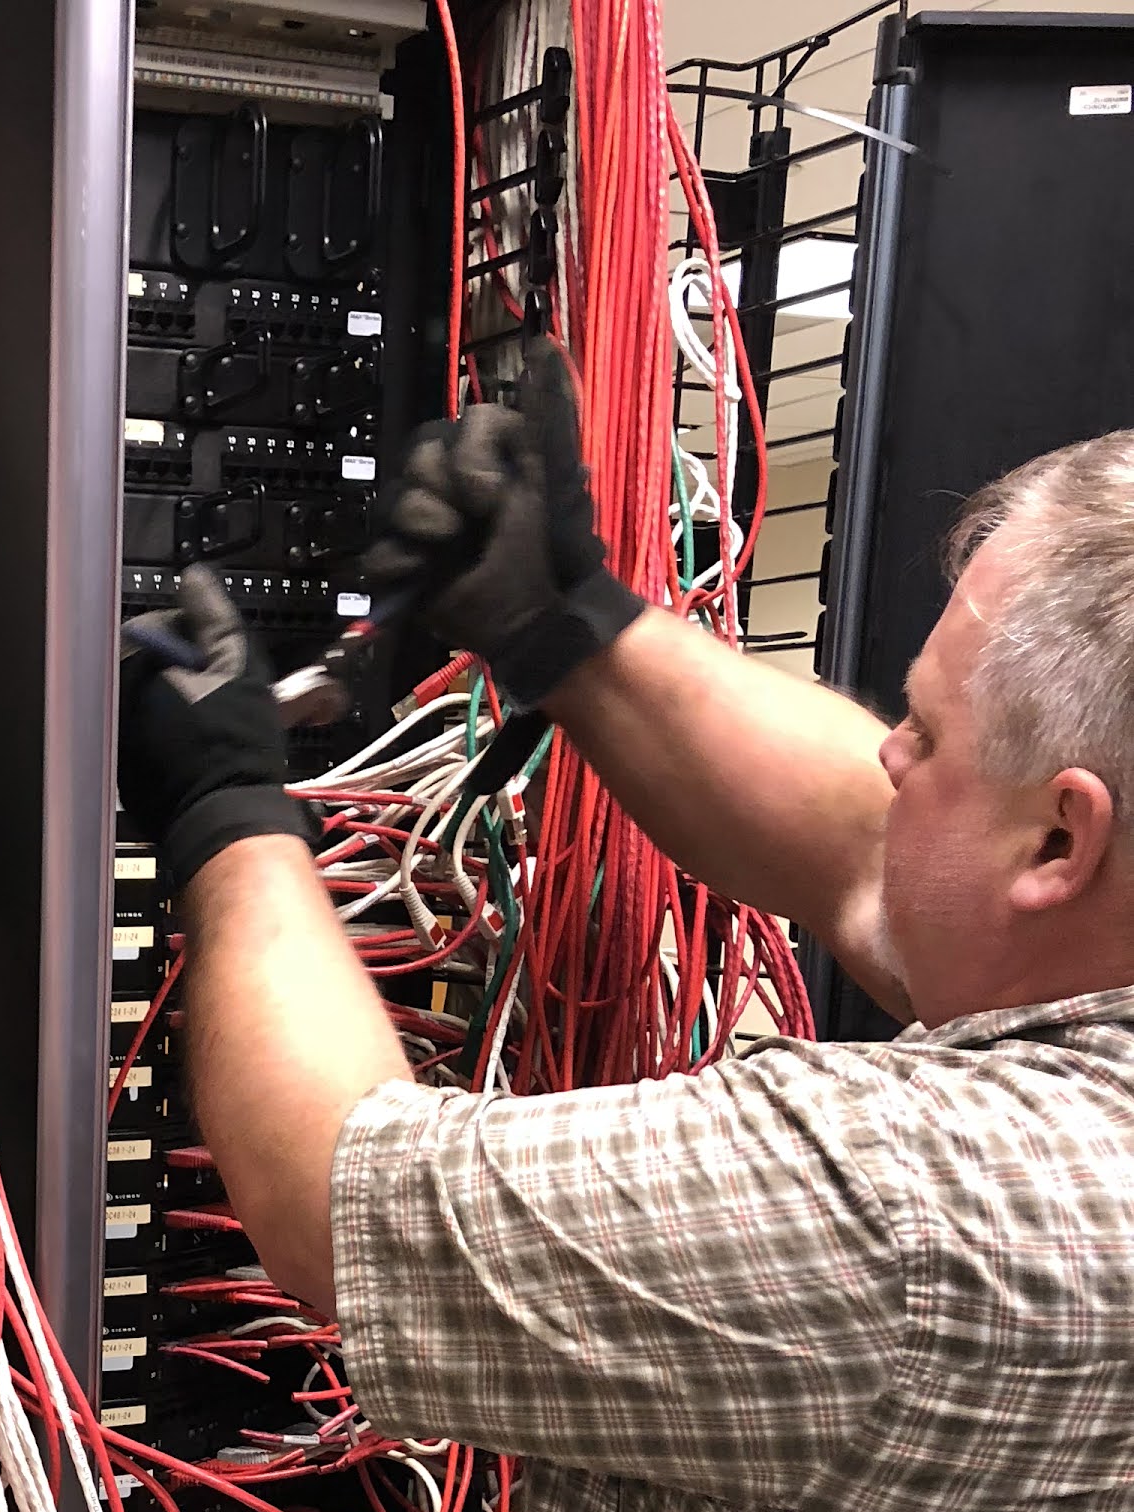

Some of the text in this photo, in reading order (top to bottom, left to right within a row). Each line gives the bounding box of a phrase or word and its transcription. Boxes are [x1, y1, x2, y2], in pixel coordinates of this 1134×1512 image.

[159, 282, 168, 290] 17
[232, 288, 241, 297] 19
[252, 290, 261, 299] 20
[271, 292, 280, 300] 21
[291, 294, 300, 302] 22
[228, 436, 237, 445] 19
[247, 437, 256, 446] 20
[267, 439, 276, 447] 21
[286, 440, 295, 448] 22
[133, 573, 143, 582] 16
[153, 575, 162, 583] 17
[243, 577, 253, 586] 20
[263, 578, 272, 587] 21
[282, 579, 291, 588] 22
[302, 580, 310, 588] 23
